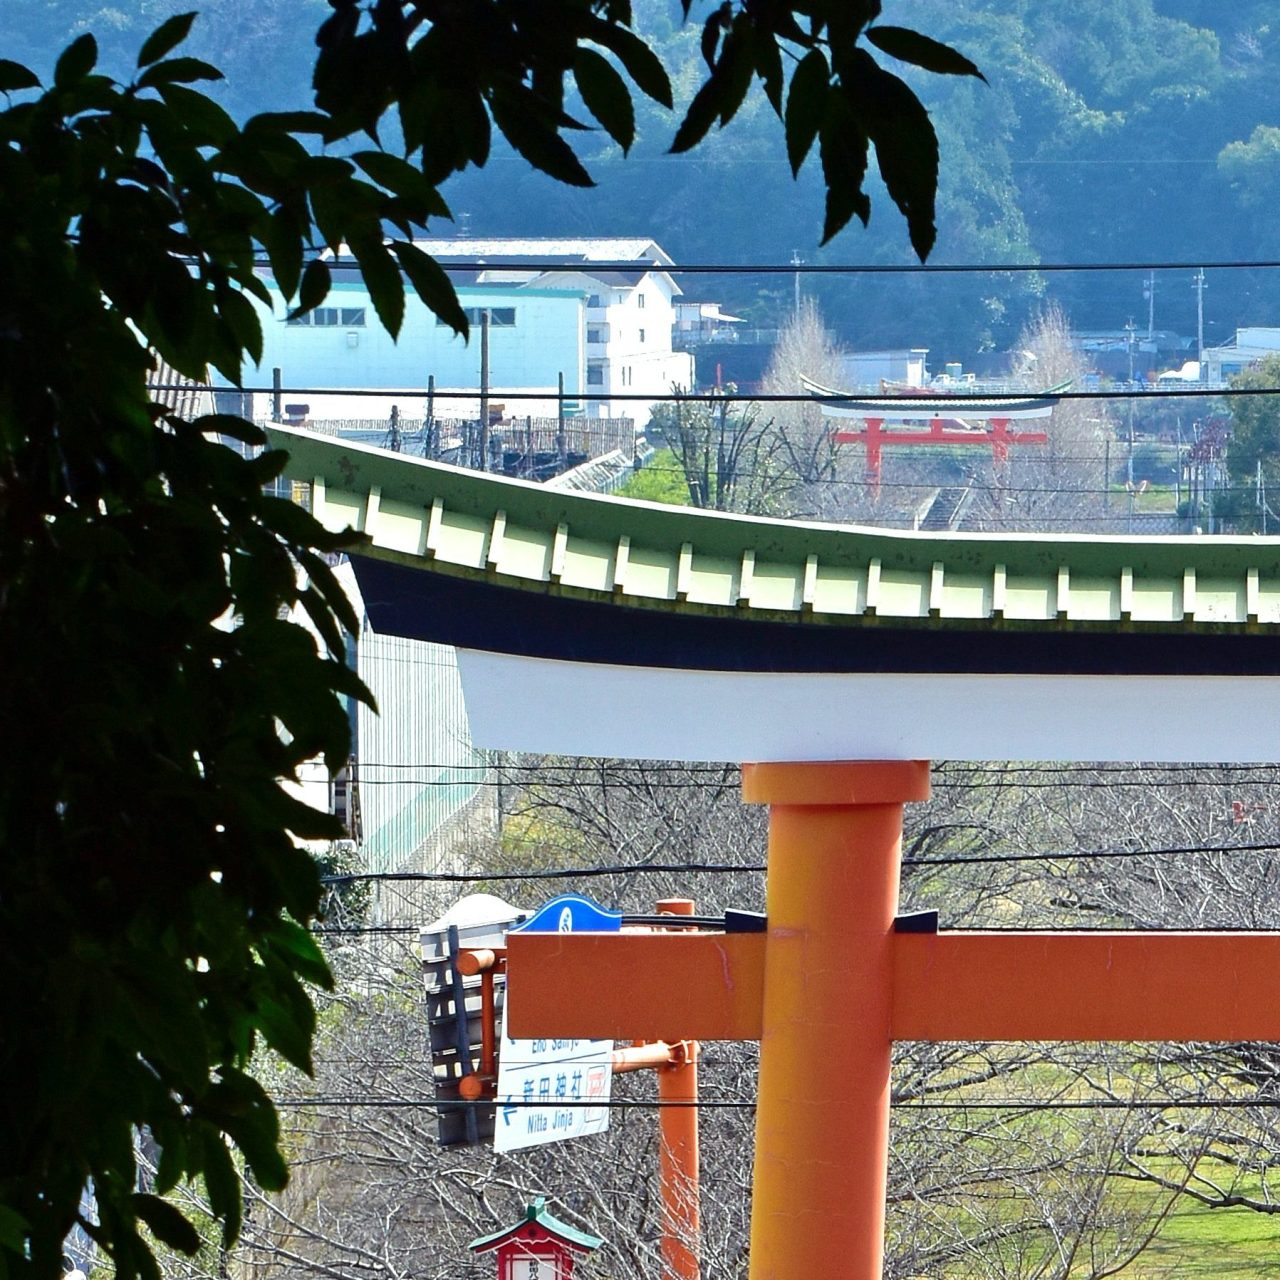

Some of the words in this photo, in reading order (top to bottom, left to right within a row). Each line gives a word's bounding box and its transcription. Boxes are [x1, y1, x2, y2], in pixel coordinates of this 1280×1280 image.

[523, 1070, 582, 1104] 新田神社
[528, 1114, 548, 1134] Nitta
[552, 1109, 573, 1132] Jinja
